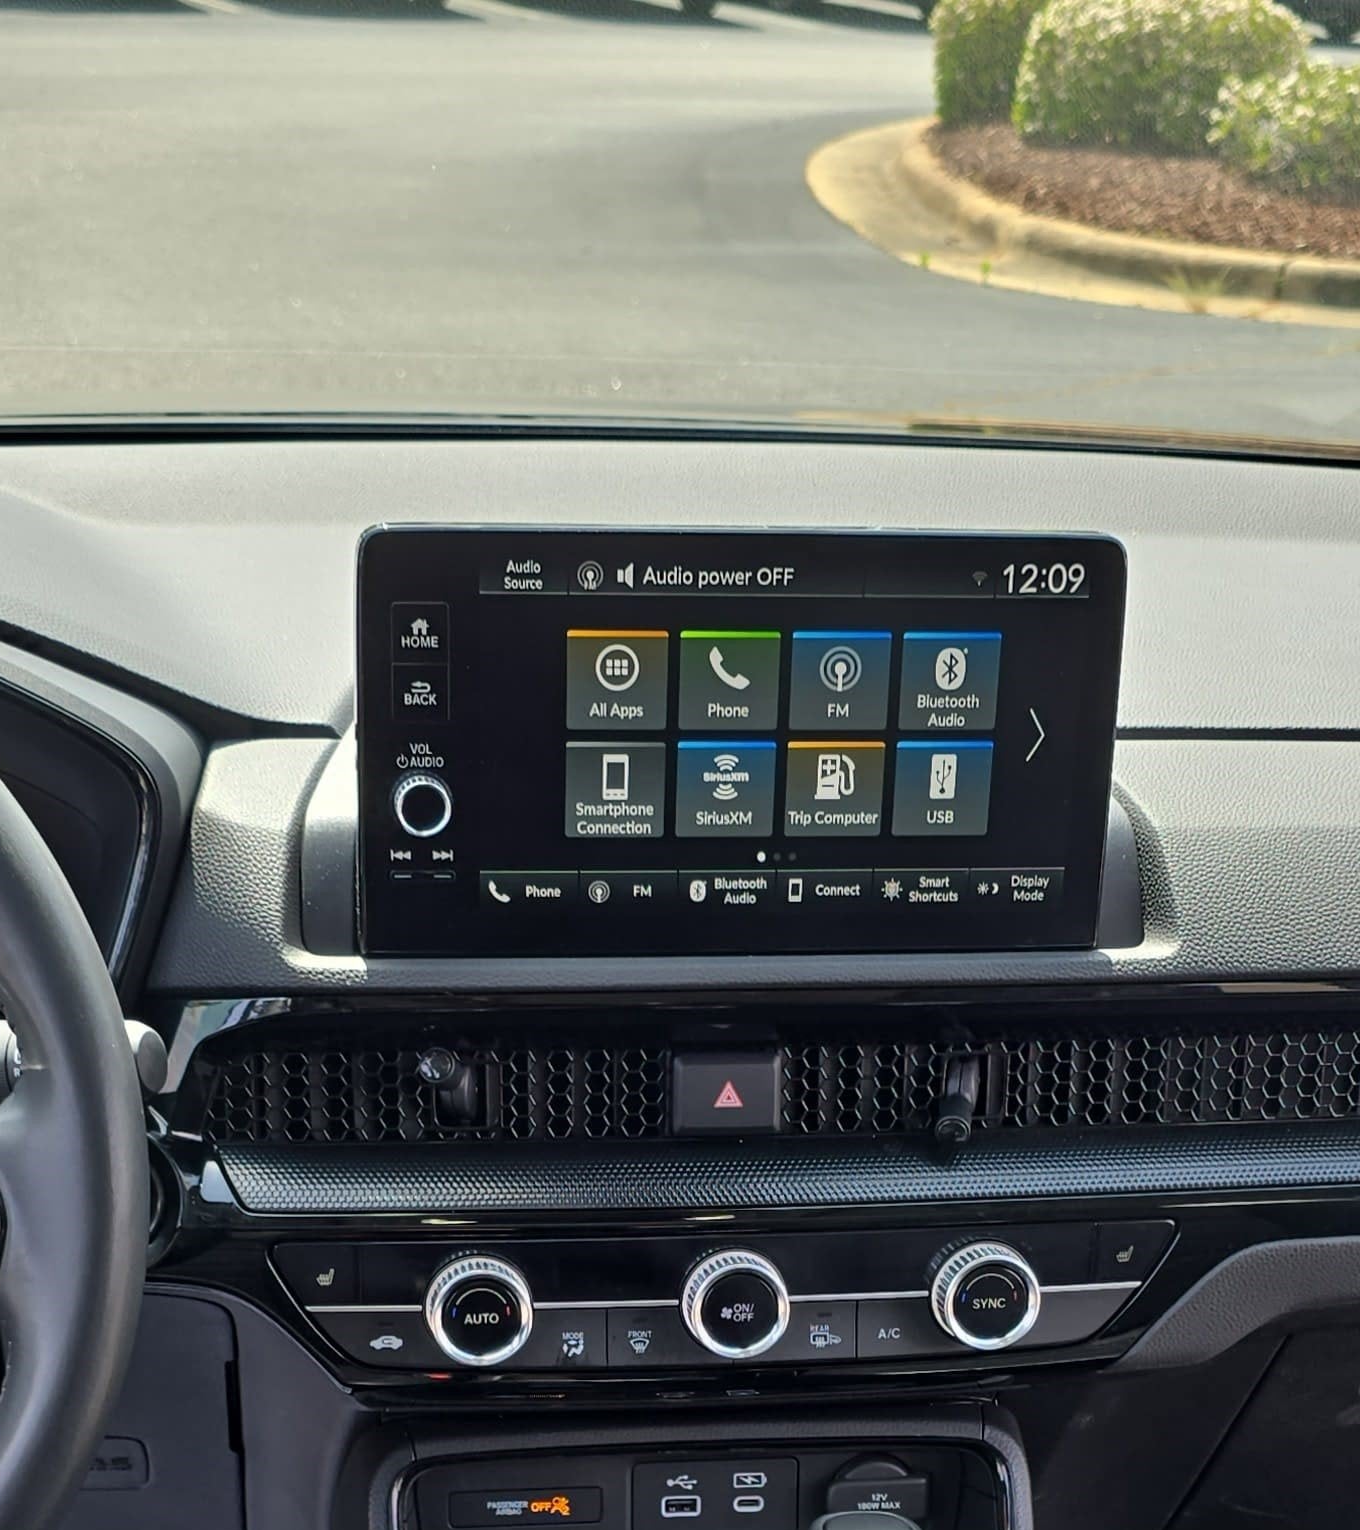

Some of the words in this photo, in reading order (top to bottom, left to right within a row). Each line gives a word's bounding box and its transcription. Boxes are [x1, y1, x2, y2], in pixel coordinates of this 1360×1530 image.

[506, 560, 541, 574] Audio
[504, 576, 543, 591] Source
[642, 566, 692, 586] Audio
[697, 569, 752, 589] power
[756, 567, 795, 586] OFF
[1002, 563, 1086, 594] 12:09
[401, 635, 439, 648] HOME
[403, 693, 437, 706] BACK
[916, 693, 980, 709] Bluetooth
[589, 702, 608, 717] All
[610, 702, 643, 719] Apps
[707, 702, 749, 718] Phone
[827, 703, 849, 718] FM
[927, 713, 965, 728] Audio
[409, 742, 432, 755] VOL
[410, 756, 444, 768] AUDIO
[575, 802, 654, 818] Smartphone
[695, 811, 752, 825] SiriusXM
[788, 811, 811, 827] Trip
[814, 811, 878, 827] Computer
[926, 810, 954, 824] USB
[576, 821, 652, 835] Connection
[714, 878, 767, 890] Bluetooth
[919, 876, 949, 888] Smart
[1011, 875, 1050, 890] Display
[525, 884, 561, 900] Phone
[633, 885, 652, 897] FM
[815, 885, 860, 897] Connect
[908, 890, 958, 902] Shortcuts
[1013, 890, 1044, 901] Mode
[723, 892, 757, 905] Audio
[733, 1303, 755, 1314] ON/
[972, 1297, 1006, 1310] SYNC
[463, 1313, 500, 1326] AUTO
[733, 1312, 755, 1323] OFF
[562, 1331, 584, 1340] MODE
[627, 1330, 653, 1340] FRONT
[878, 1327, 901, 1339] A/C
[871, 1493, 888, 1501] 12V
[530, 1502, 551, 1512] OFF
[880, 1501, 901, 1510] MAX
